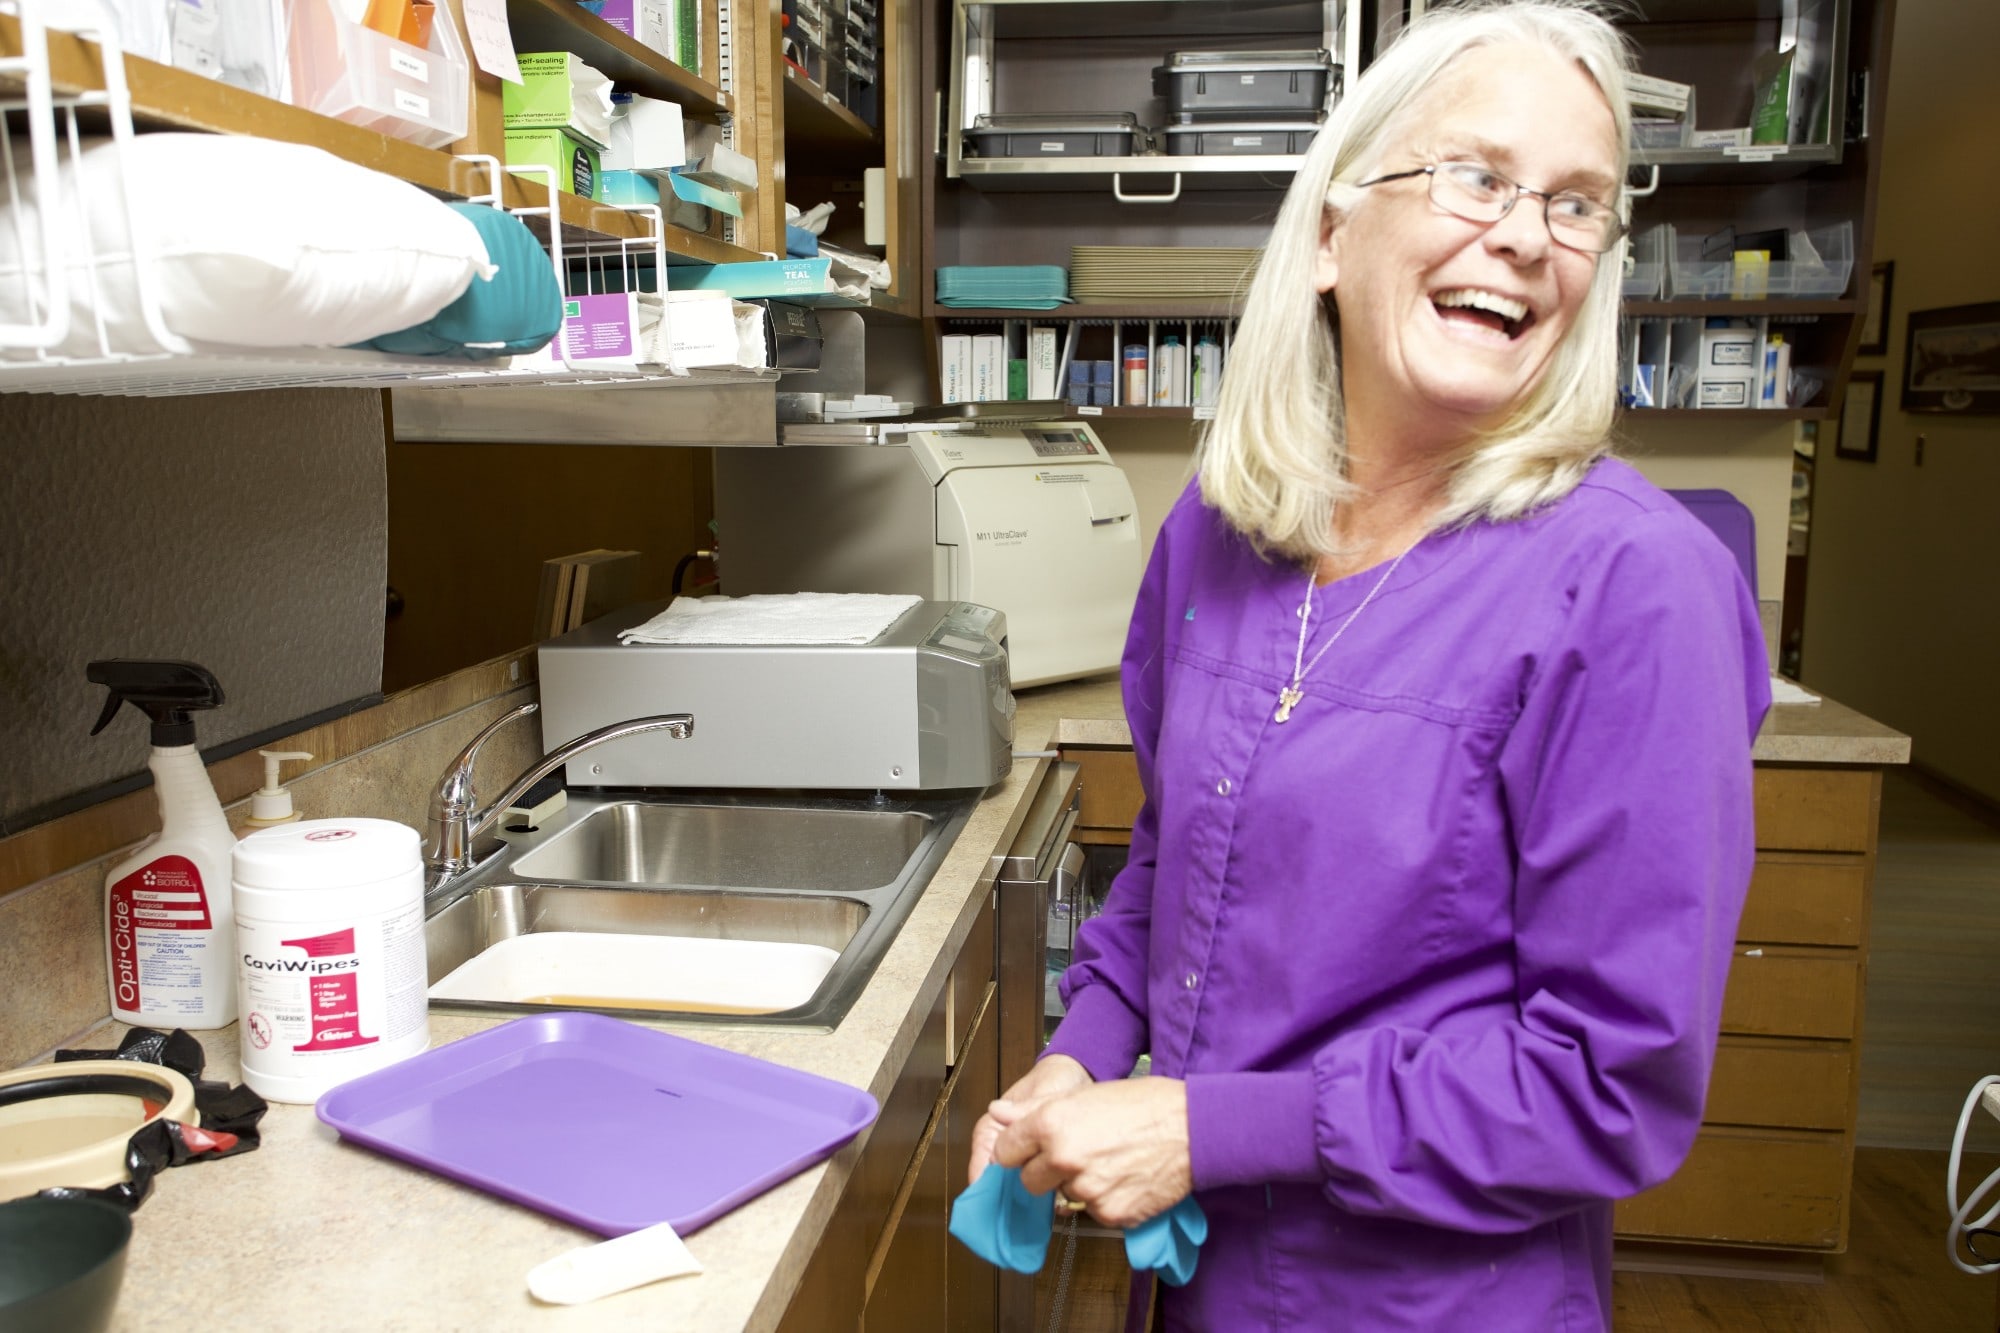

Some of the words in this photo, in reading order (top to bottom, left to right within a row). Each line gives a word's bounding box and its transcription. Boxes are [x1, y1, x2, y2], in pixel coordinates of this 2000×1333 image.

[517, 57, 565, 65] self-sealing
[784, 271, 810, 279] TEAL
[976, 532, 991, 541] M11
[993, 530, 1028, 540] UltraClave
[157, 879, 193, 887] BIOTROL
[243, 954, 360, 974] CaviWipes
[276, 1014, 306, 1022] WARNING
